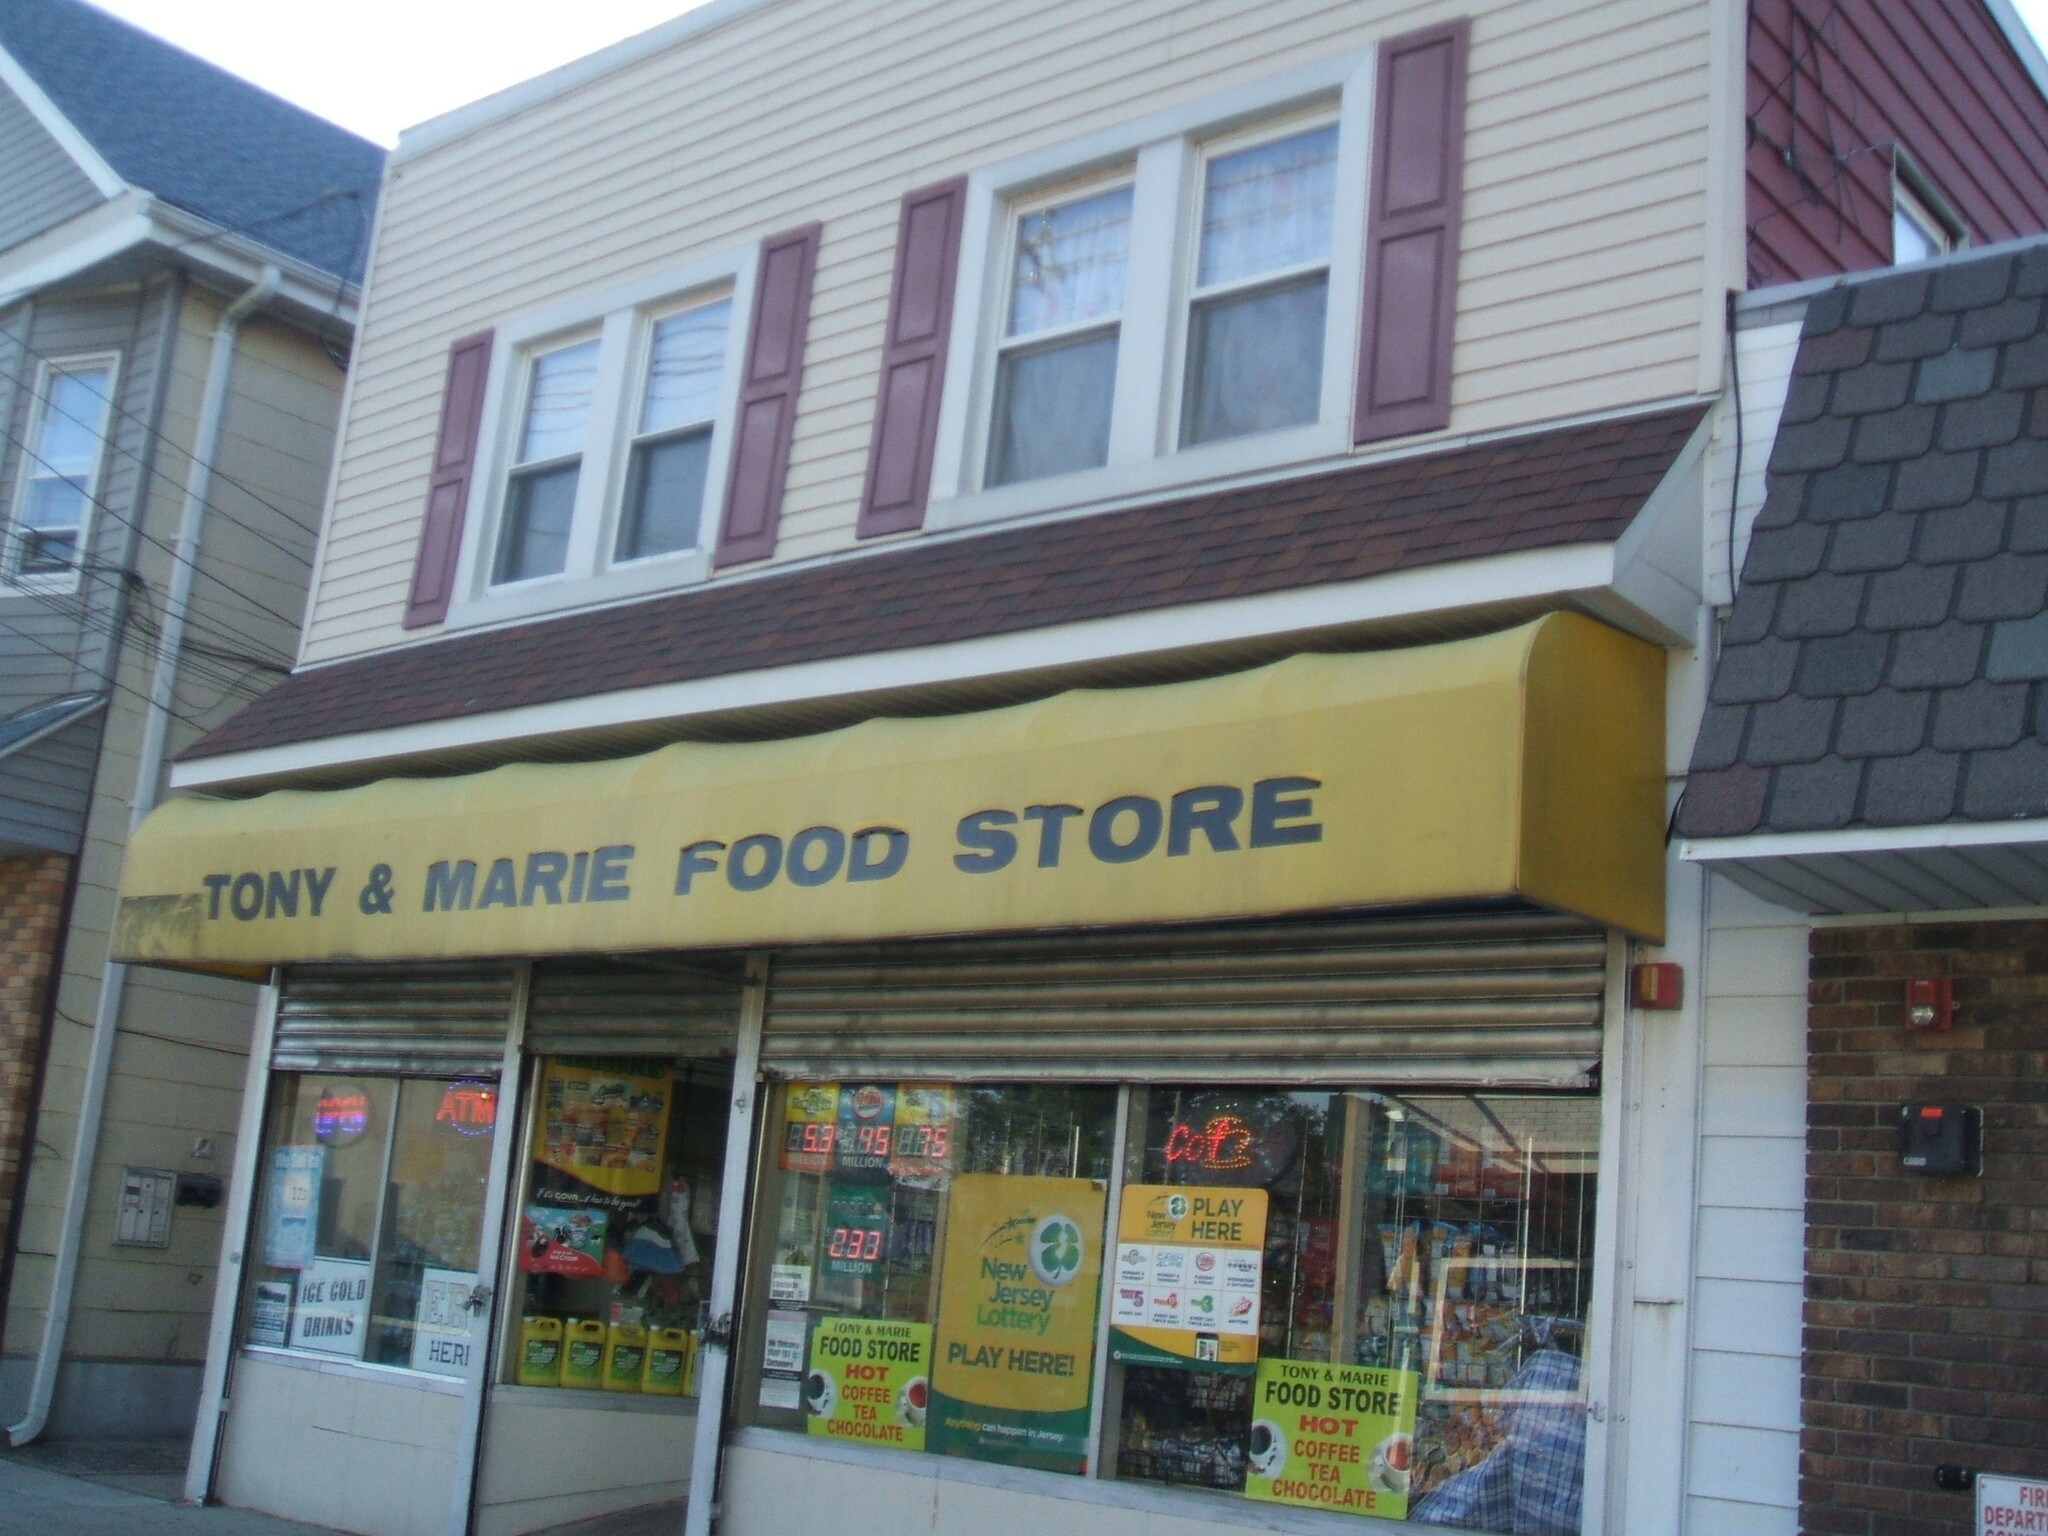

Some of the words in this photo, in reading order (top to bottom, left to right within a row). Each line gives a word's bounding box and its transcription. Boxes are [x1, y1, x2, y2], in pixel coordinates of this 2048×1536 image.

[203, 866, 337, 922] TONY
[359, 863, 395, 914] &
[423, 844, 635, 913] MARIE
[675, 825, 909, 896] FOOD
[953, 776, 1322, 874] STORE
[436, 1091, 496, 1123] ATM
[788, 1153, 827, 1165] MILLION
[842, 1157, 883, 1168] MILLION
[1192, 1198, 1243, 1218] PLAY
[1191, 1221, 1242, 1241] HERE
[831, 1260, 872, 1274] MILLION
[980, 1257, 1027, 1282] New
[302, 1280, 325, 1304] ICE
[329, 1278, 366, 1302] COLD
[989, 1280, 1055, 1312] Jersey
[303, 1315, 354, 1338] DRINKS
[833, 1321, 861, 1337] TONY
[864, 1324, 871, 1336] &
[873, 1323, 912, 1338] MARIE
[976, 1305, 1051, 1336] Lottery
[819, 1336, 862, 1358] FOOD
[867, 1339, 921, 1363] STORE
[949, 1342, 1004, 1368] PLAY
[1008, 1351, 1075, 1378] HERE!
[845, 1364, 889, 1382] HOT
[1281, 1364, 1320, 1381] TONY
[1324, 1367, 1333, 1381] &
[1339, 1370, 1388, 1387] MARIE
[842, 1385, 891, 1404] COFFEE
[1265, 1381, 1321, 1408] FOOD
[1328, 1387, 1401, 1416] STORE
[853, 1404, 877, 1421] TEA
[827, 1418, 903, 1442] CHOCOLATE
[982, 1423, 996, 1433] can
[997, 1425, 1027, 1438] happen
[1028, 1428, 1036, 1438] in
[1299, 1416, 1359, 1437] HOT
[1294, 1439, 1360, 1464] COFFEE
[1308, 1463, 1341, 1483] TEA
[1272, 1478, 1376, 1509] CHOCOLATE
[1984, 1506, 2048, 1531] DEPART
